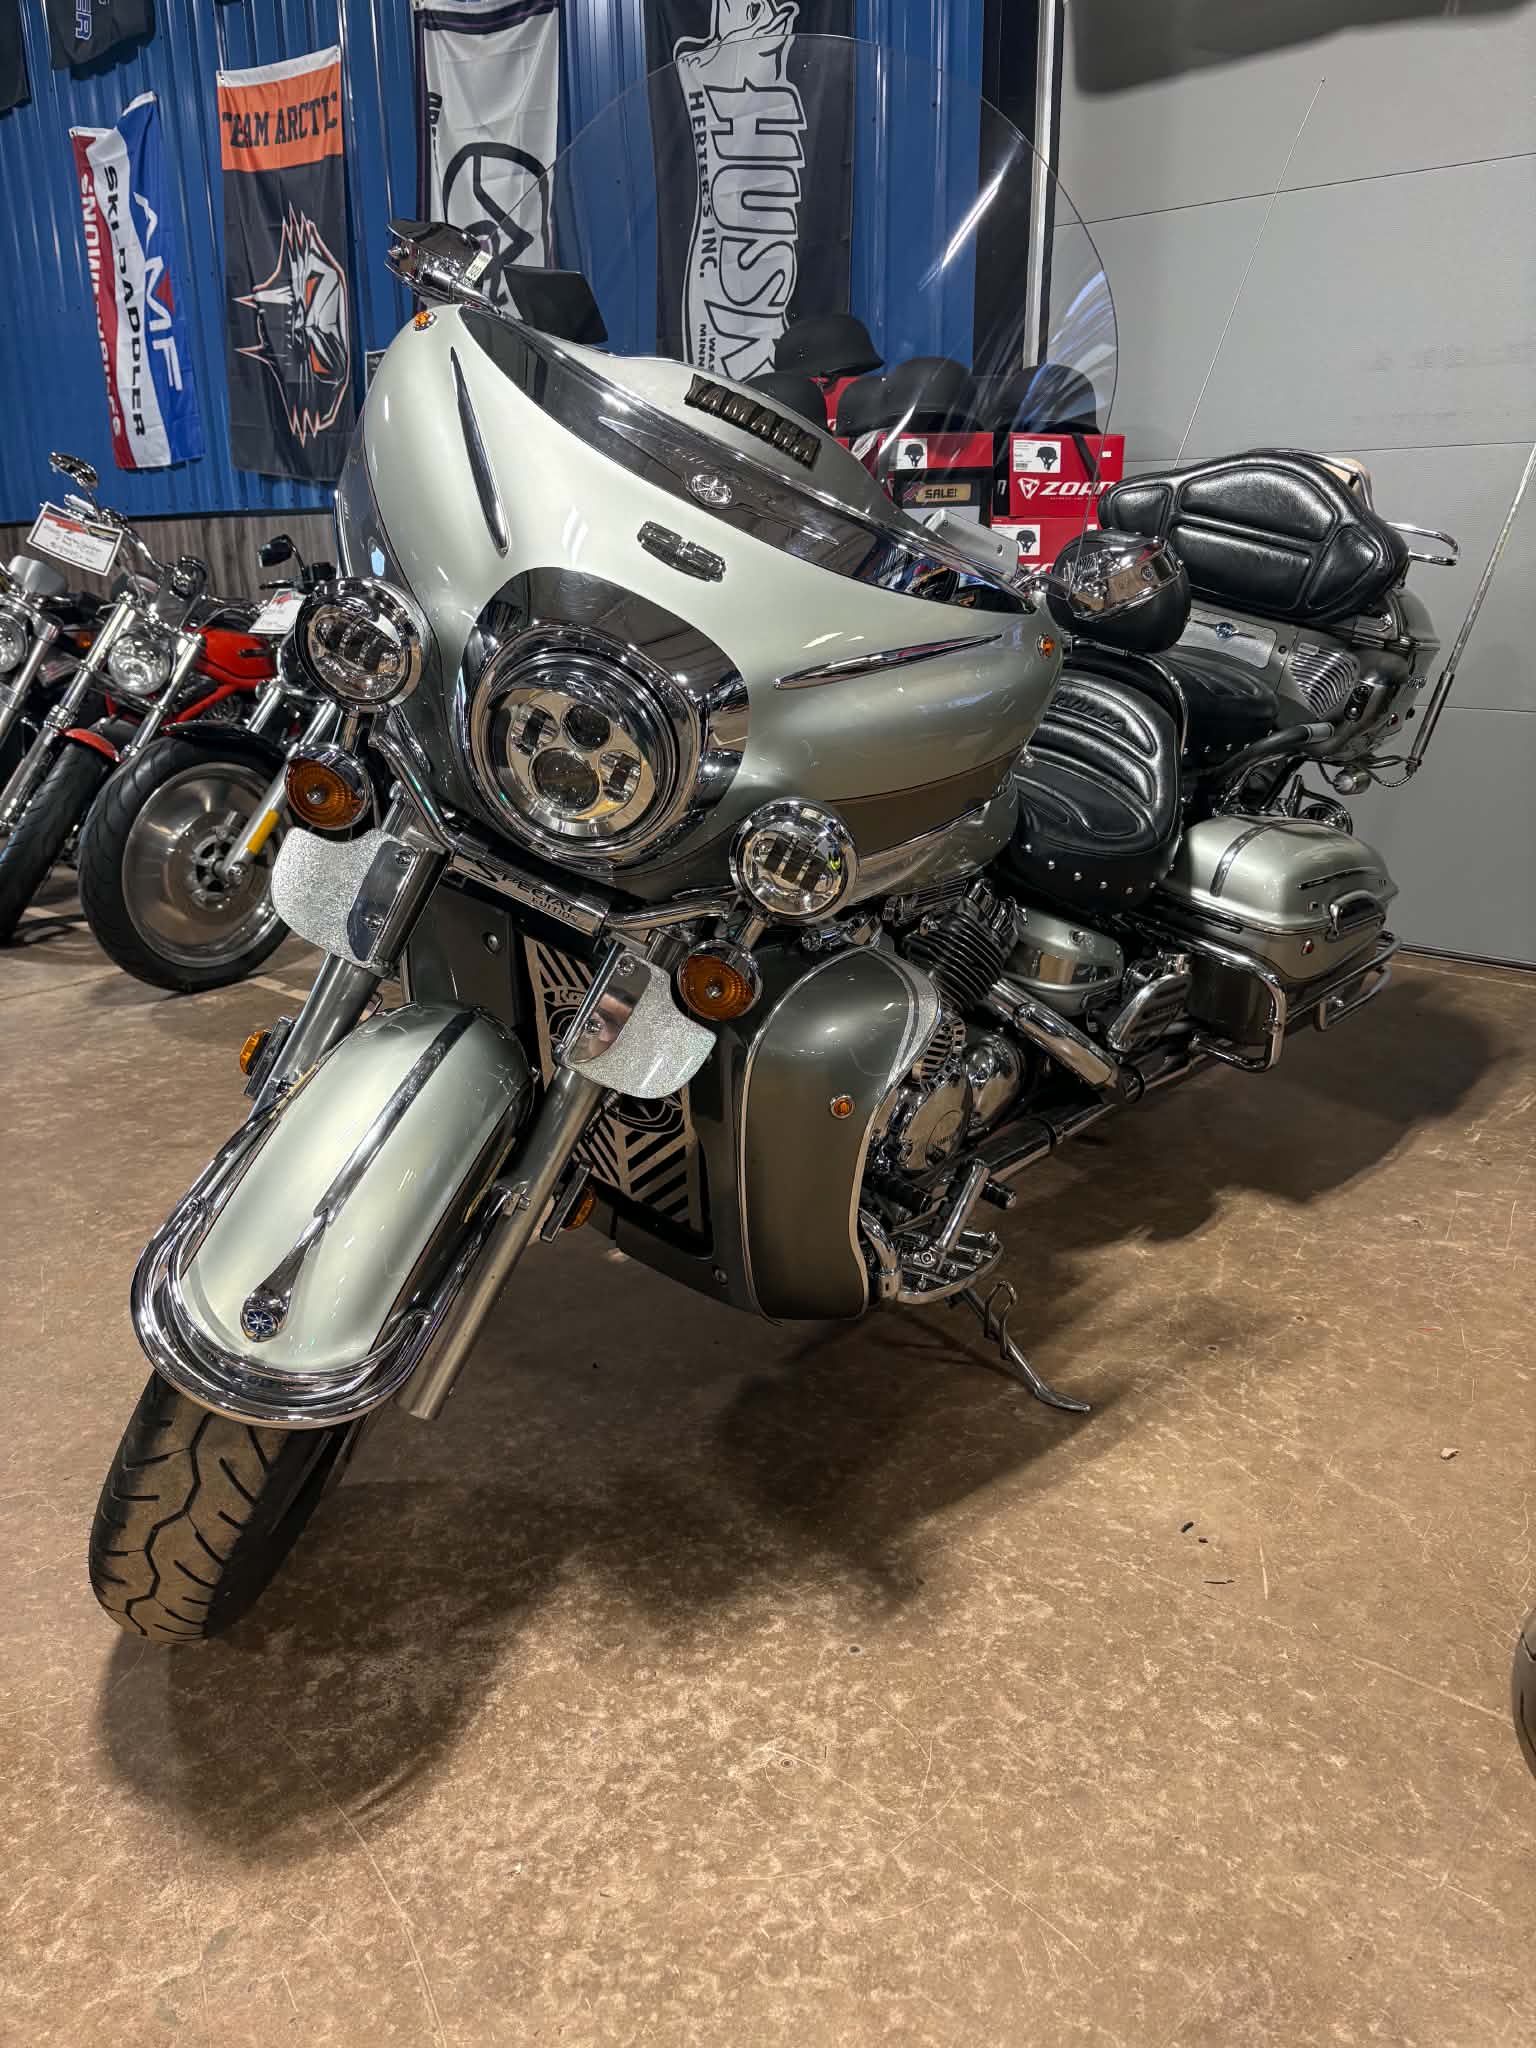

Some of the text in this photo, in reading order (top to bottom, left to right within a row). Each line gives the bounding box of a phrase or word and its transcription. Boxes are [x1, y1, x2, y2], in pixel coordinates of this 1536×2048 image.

[689, 91, 718, 278] HERTER'S INC.
[104, 165, 146, 436] SKI-DADDLER
[684, 374, 822, 472] YAMAHA
[925, 488, 957, 499] SALE!
